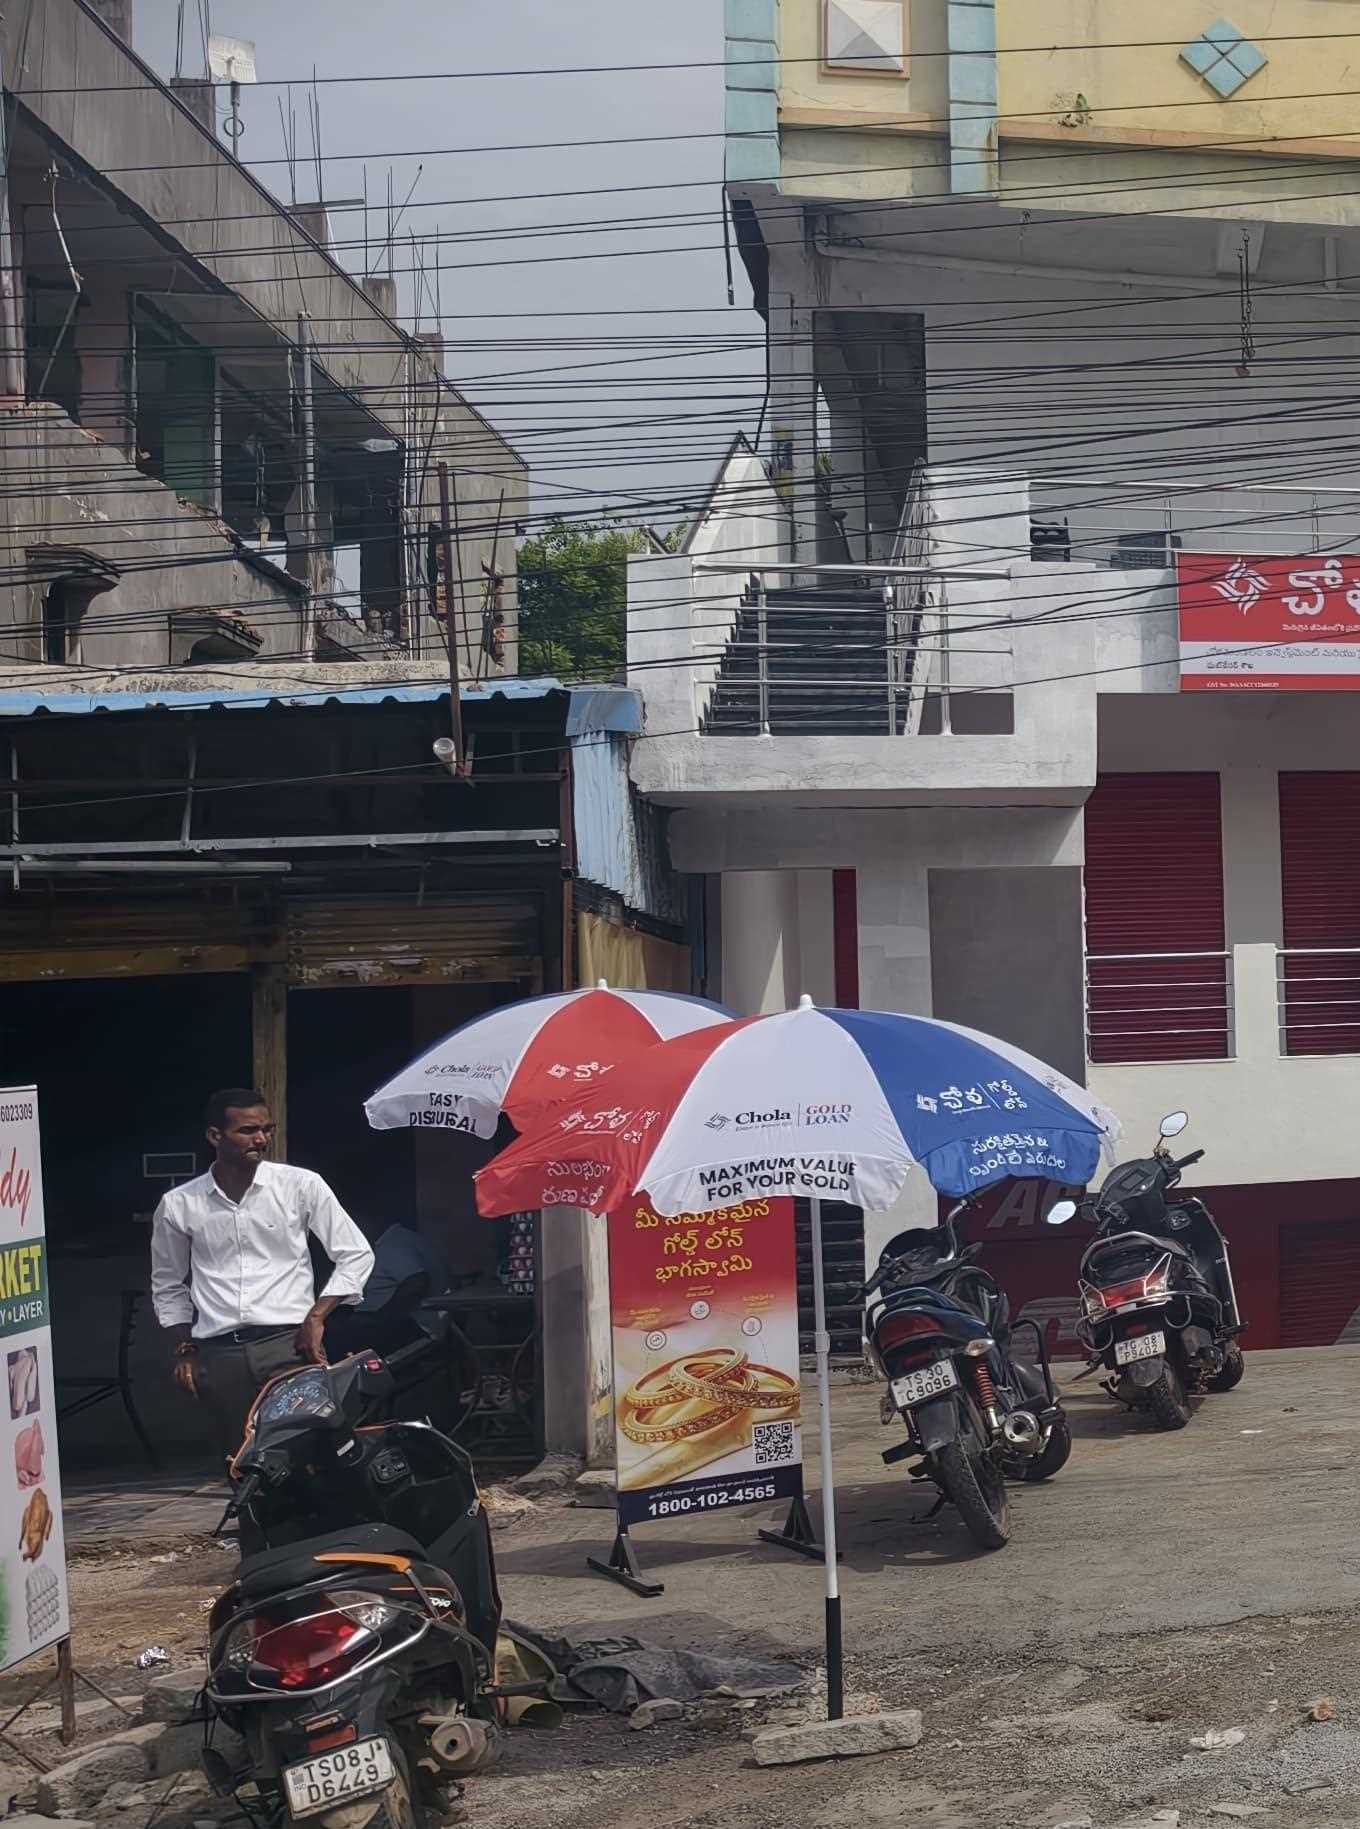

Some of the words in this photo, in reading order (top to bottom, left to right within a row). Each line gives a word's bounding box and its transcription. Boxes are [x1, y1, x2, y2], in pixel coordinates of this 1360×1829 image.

[735, 1109, 791, 1125] Chola
[805, 1113, 850, 1126] LOAN
[806, 1104, 852, 1115] GOLD
[699, 1157, 795, 1186] MAXIMUM
[800, 1158, 856, 1176] VALUE
[707, 1181, 742, 1201] FOR
[746, 1171, 796, 1189] YOUR
[800, 1173, 849, 1191] GOLD
[635, 1207, 658, 1229] మీ
[704, 1227, 744, 1250] లోన్
[655, 1254, 753, 1283] భాగస్వామి
[904, 1373, 923, 1388] TS
[926, 1364, 943, 1380] 30
[906, 1374, 951, 1401] C9096
[648, 1484, 776, 1516] 1800-102-4565
[307, 1764, 379, 1804] D6449
